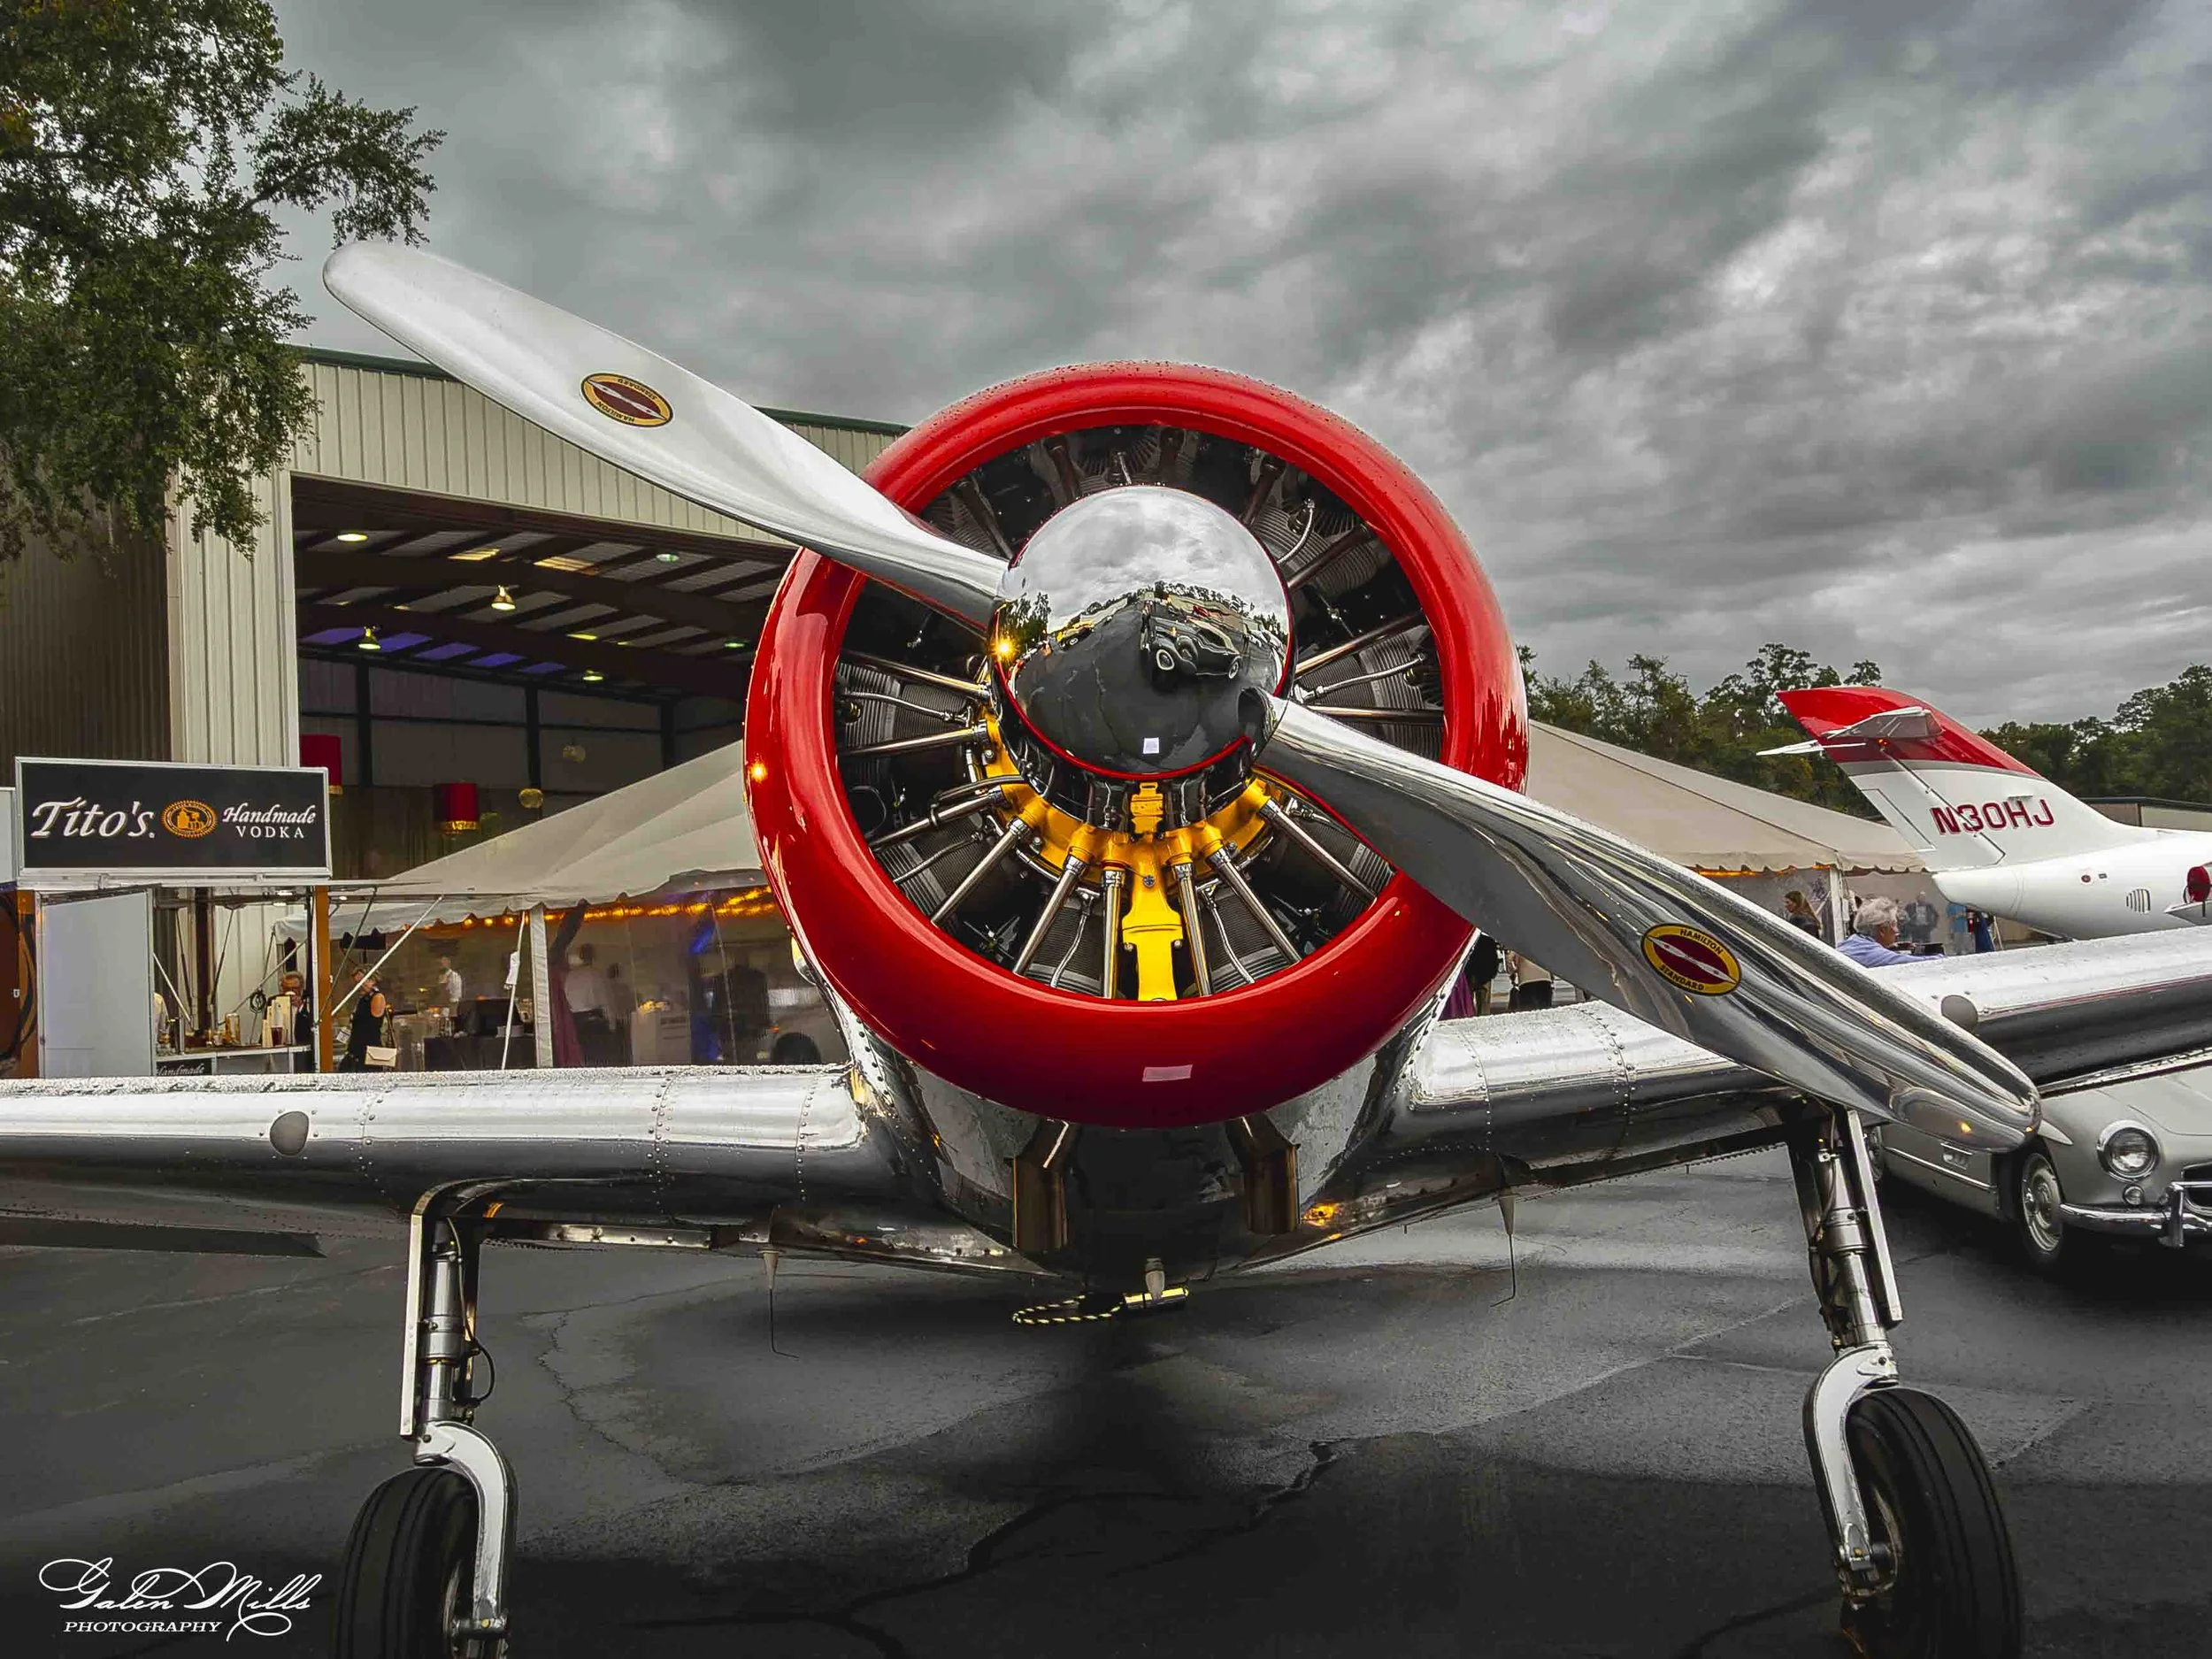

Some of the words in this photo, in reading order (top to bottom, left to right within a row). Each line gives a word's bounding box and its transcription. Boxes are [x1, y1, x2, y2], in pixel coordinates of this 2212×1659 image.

[618, 378, 658, 400] STANDARD
[596, 401, 636, 423] HAMILTON
[222, 802, 317, 825] Handmade
[1929, 798, 2055, 835] N30HJ
[235, 826, 304, 839] VODKA
[1679, 928, 1724, 956] HAMILTON
[1659, 964, 1705, 991] STANDARD
